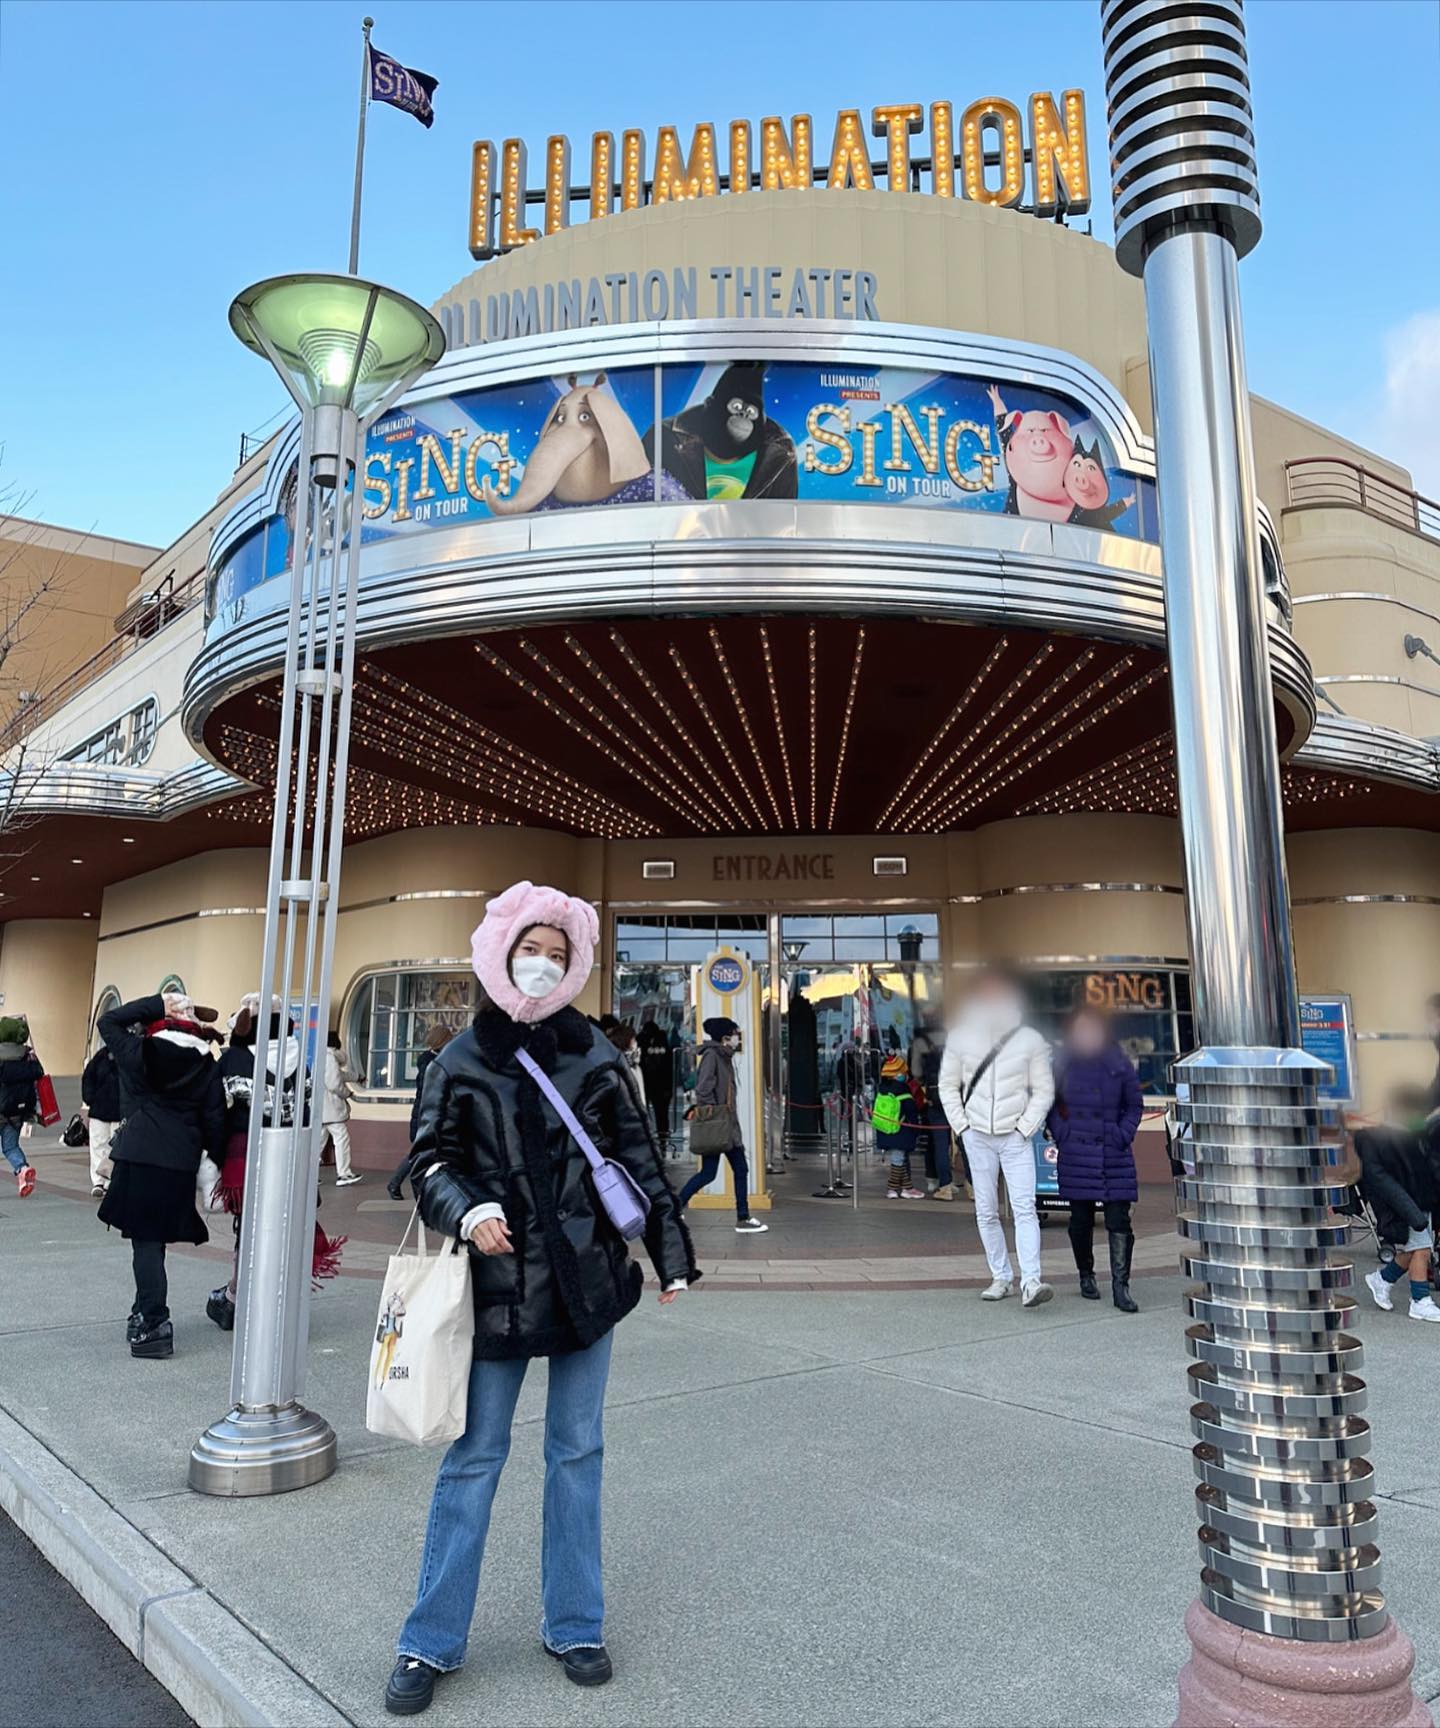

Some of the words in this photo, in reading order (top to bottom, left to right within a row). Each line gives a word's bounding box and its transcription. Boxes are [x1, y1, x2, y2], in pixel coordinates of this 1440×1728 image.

[469, 89, 1091, 260] ILLUMINATION
[440, 266, 697, 351] ILLUMINATION
[710, 266, 880, 321] THEATER
[820, 373, 880, 388] ILLUMINATION
[841, 390, 879, 400] PRESENTS
[371, 415, 416, 437] ILLUMINATION
[385, 430, 414, 443] PRESENTS
[804, 402, 1000, 492] SING
[363, 428, 517, 523] SING
[886, 475, 907, 494] ON
[913, 478, 950, 498] TOUR
[415, 503, 431, 522] ON
[435, 497, 468, 515] TOUR
[712, 853, 835, 881] ENTRANCE
[711, 968, 740, 983] SING
[1085, 973, 1164, 1009] SING
